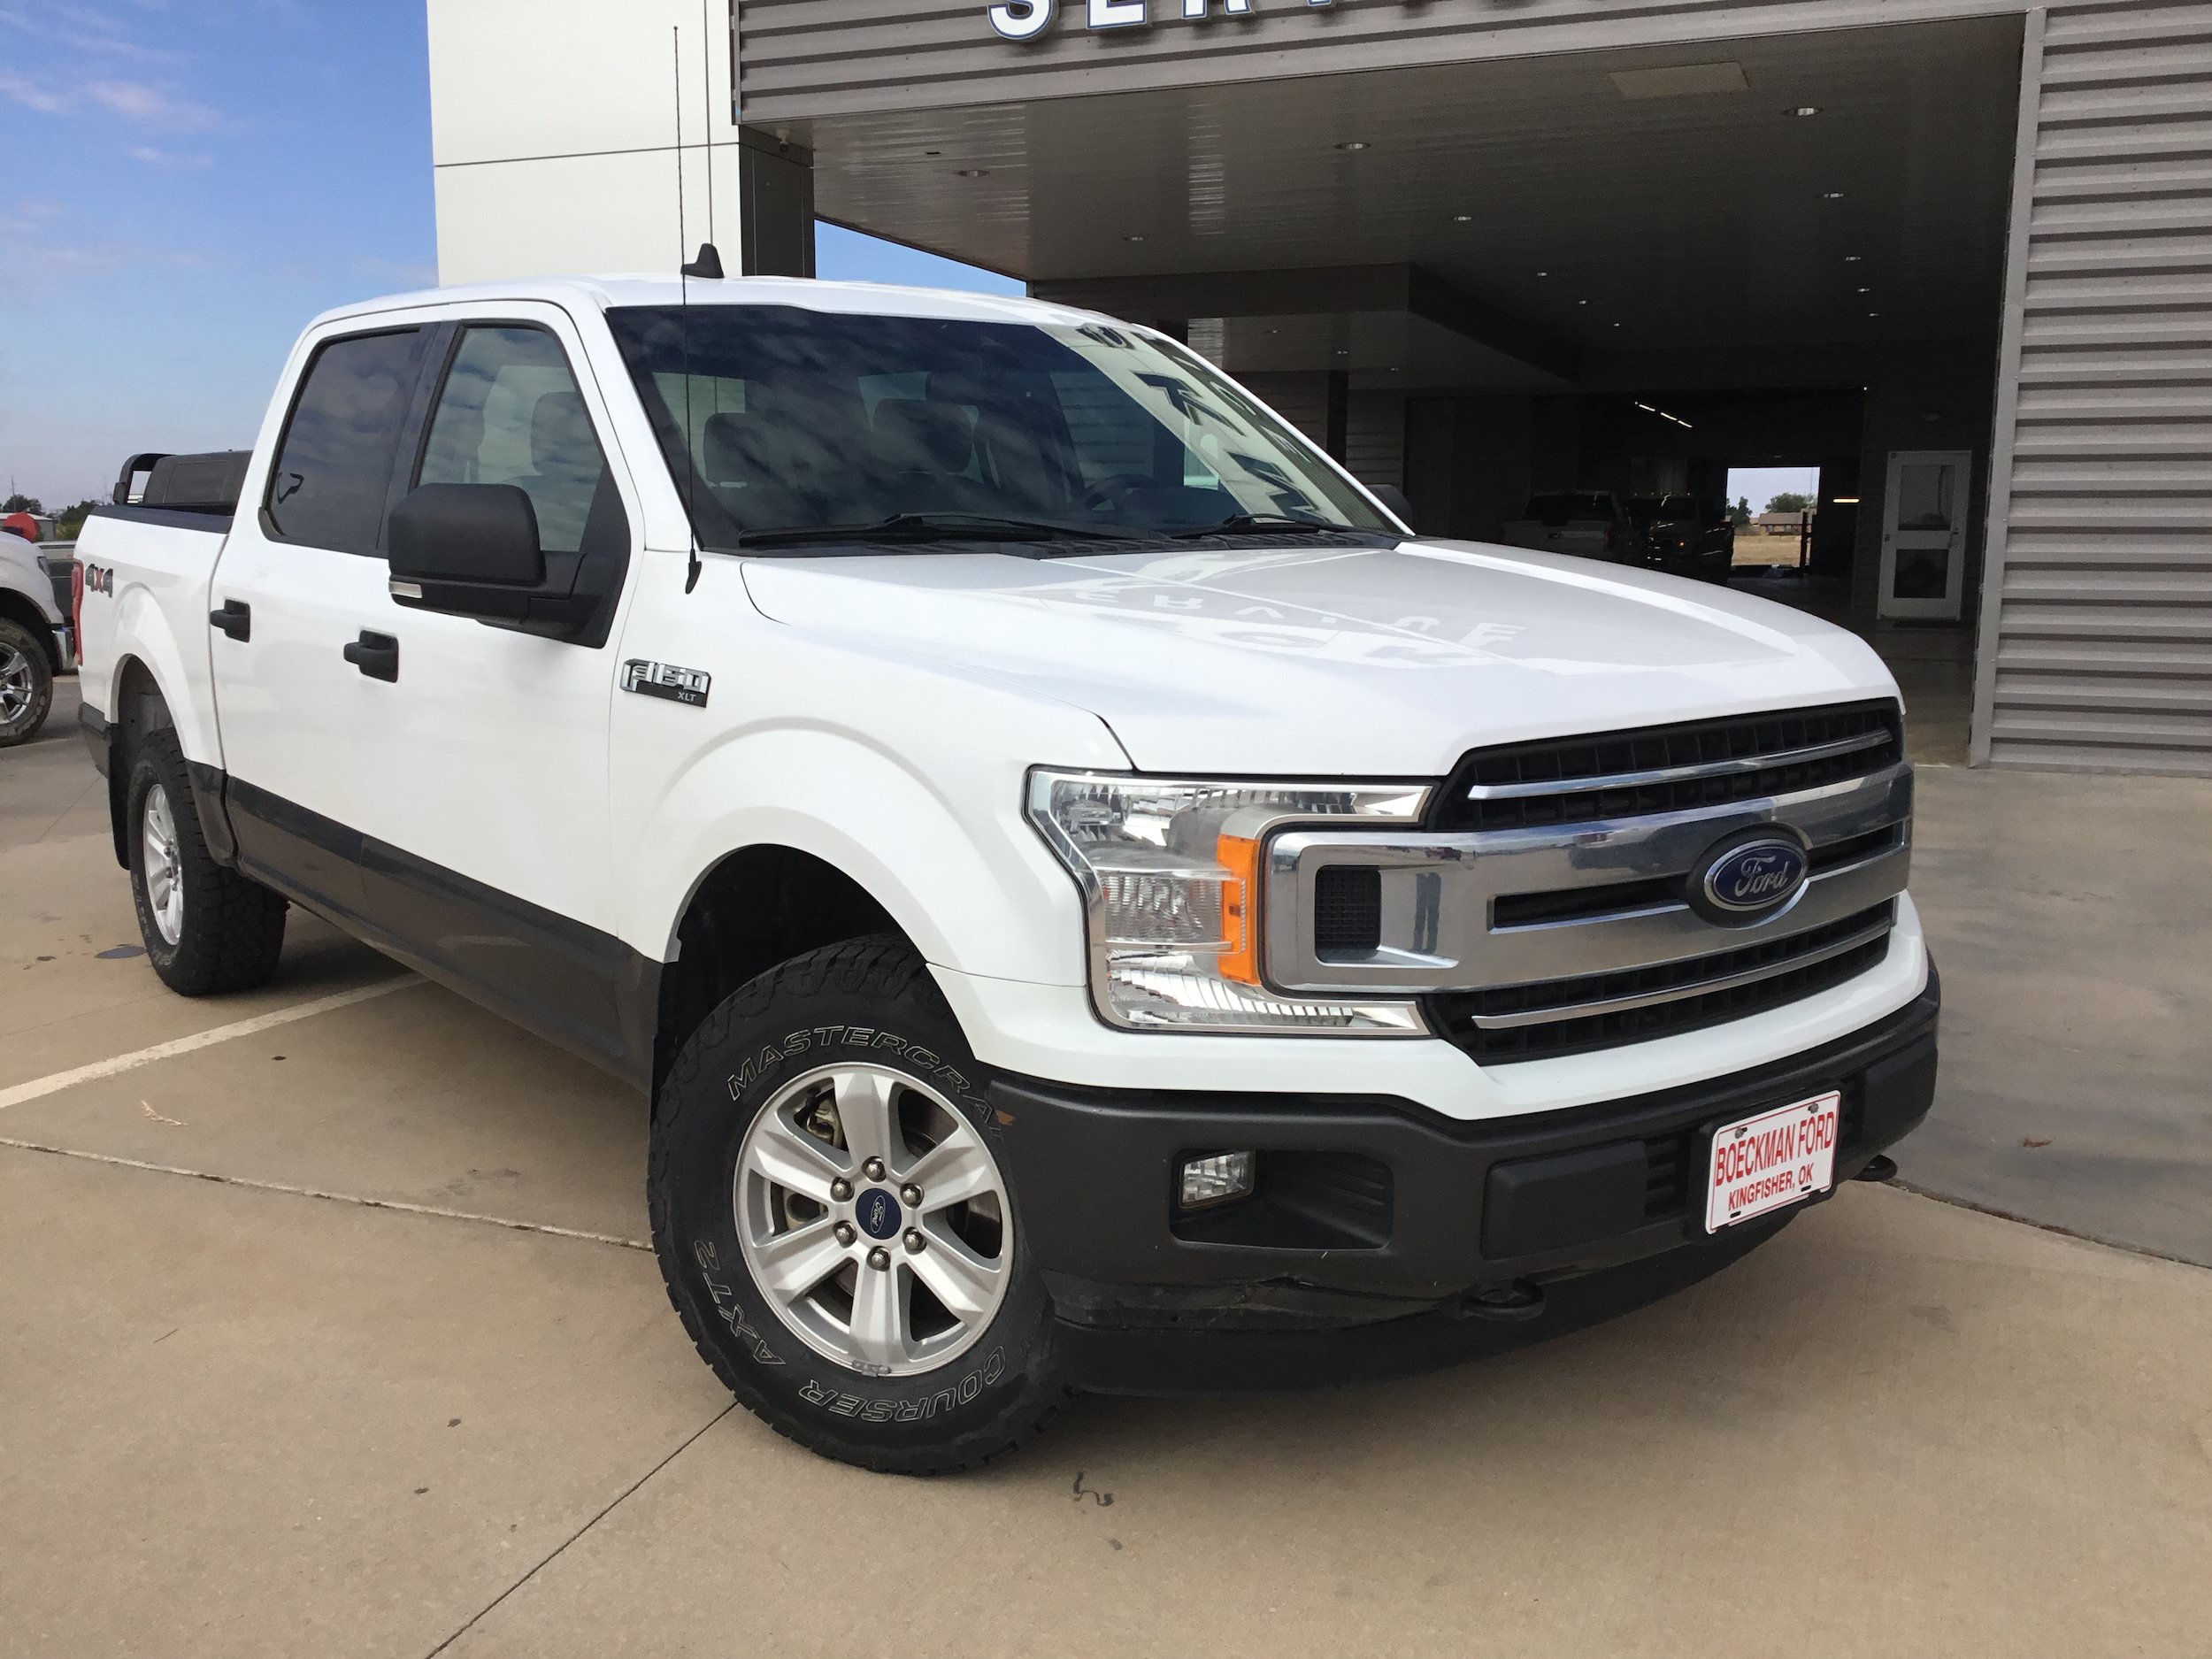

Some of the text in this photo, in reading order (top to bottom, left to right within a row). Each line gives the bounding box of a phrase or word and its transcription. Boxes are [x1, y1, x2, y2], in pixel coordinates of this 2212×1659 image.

[677, 691, 696, 703] XLT
[1734, 855, 1790, 897] Ford
[1715, 1110, 1835, 1187] BOECKMAN FORD
[1728, 1162, 1815, 1211] KINGFISHER, OK
[694, 1240, 1007, 1423] COURSER AXT2
